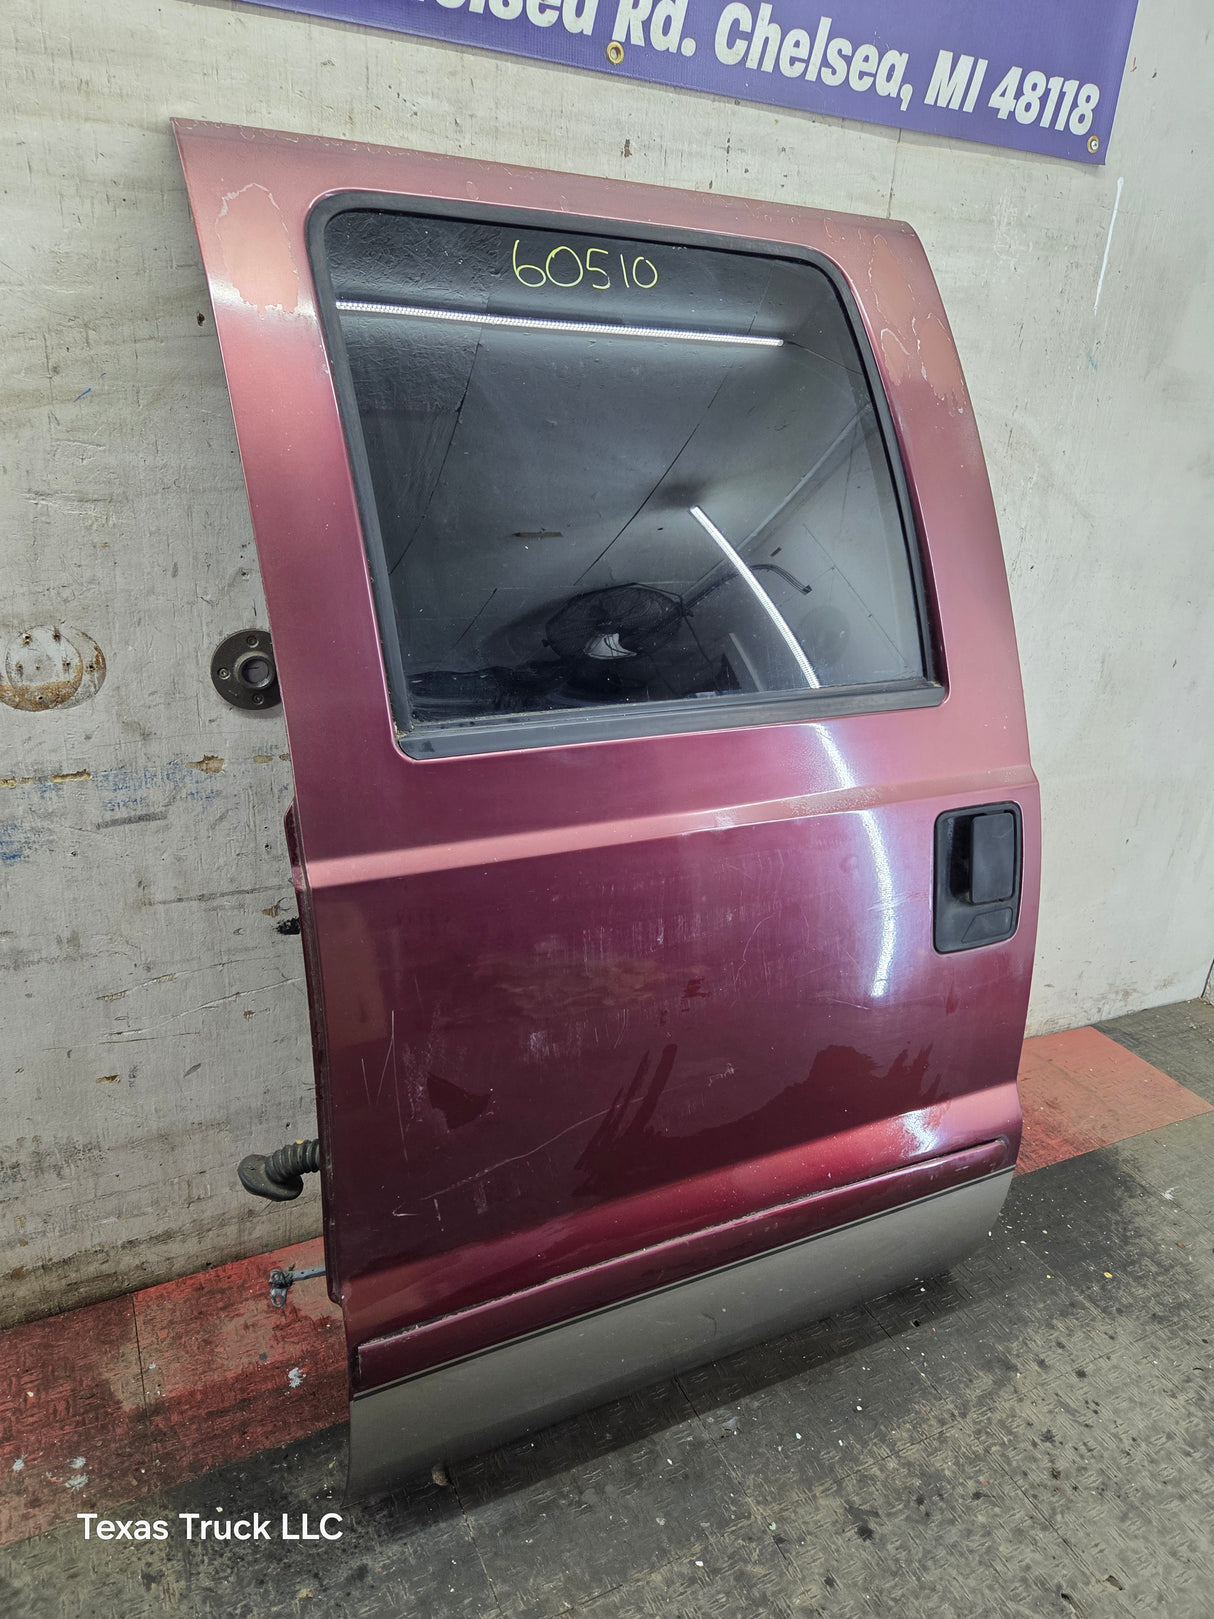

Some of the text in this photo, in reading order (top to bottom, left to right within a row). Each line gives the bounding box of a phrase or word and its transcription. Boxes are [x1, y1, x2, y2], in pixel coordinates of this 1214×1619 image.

[612, 0, 697, 57] Rd.
[714, 1, 914, 112] Chelsea,
[923, 49, 989, 113] MI
[987, 65, 1100, 136] 48118
[512, 239, 659, 290] 60510
